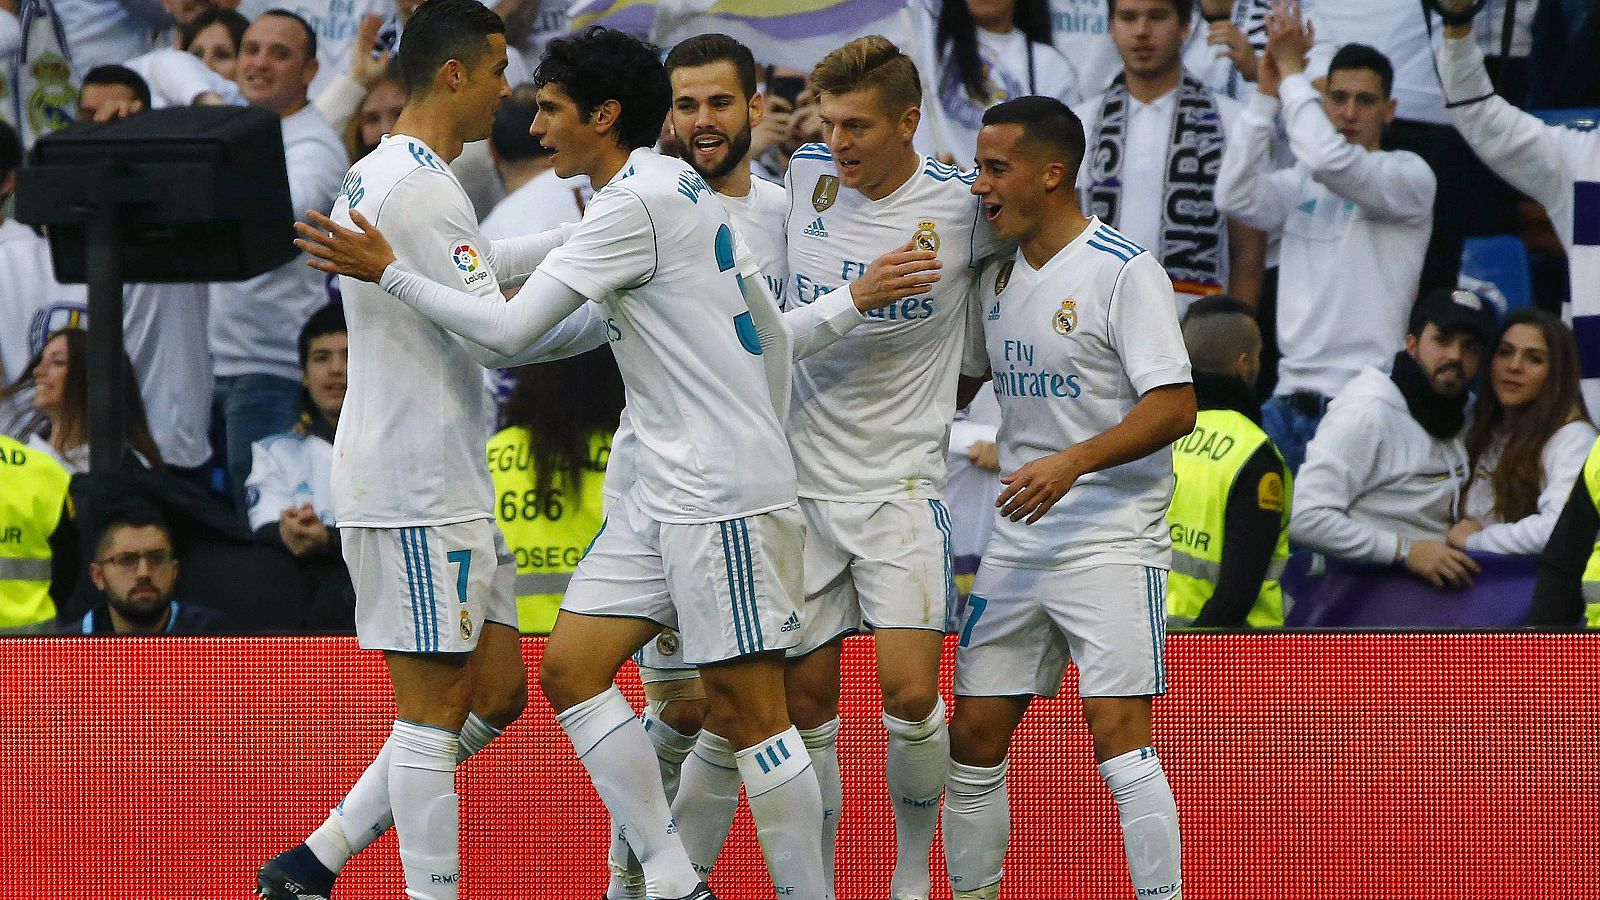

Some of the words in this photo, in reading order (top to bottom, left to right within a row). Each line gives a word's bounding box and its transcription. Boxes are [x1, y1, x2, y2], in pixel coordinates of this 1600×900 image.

[803, 227, 829, 239] adidas
[464, 271, 488, 285] LaLiga
[841, 260, 866, 281] Fl
[1004, 340, 1034, 367] Fly
[1174, 426, 1235, 461] IDAD
[0, 447, 26, 465] AD
[501, 488, 563, 522] 686
[0, 526, 21, 543] UR
[1169, 523, 1212, 551] GUR
[514, 546, 581, 568] OSEG
[447, 549, 472, 604] 7
[959, 593, 988, 648] 7
[902, 797, 938, 808] RMC
